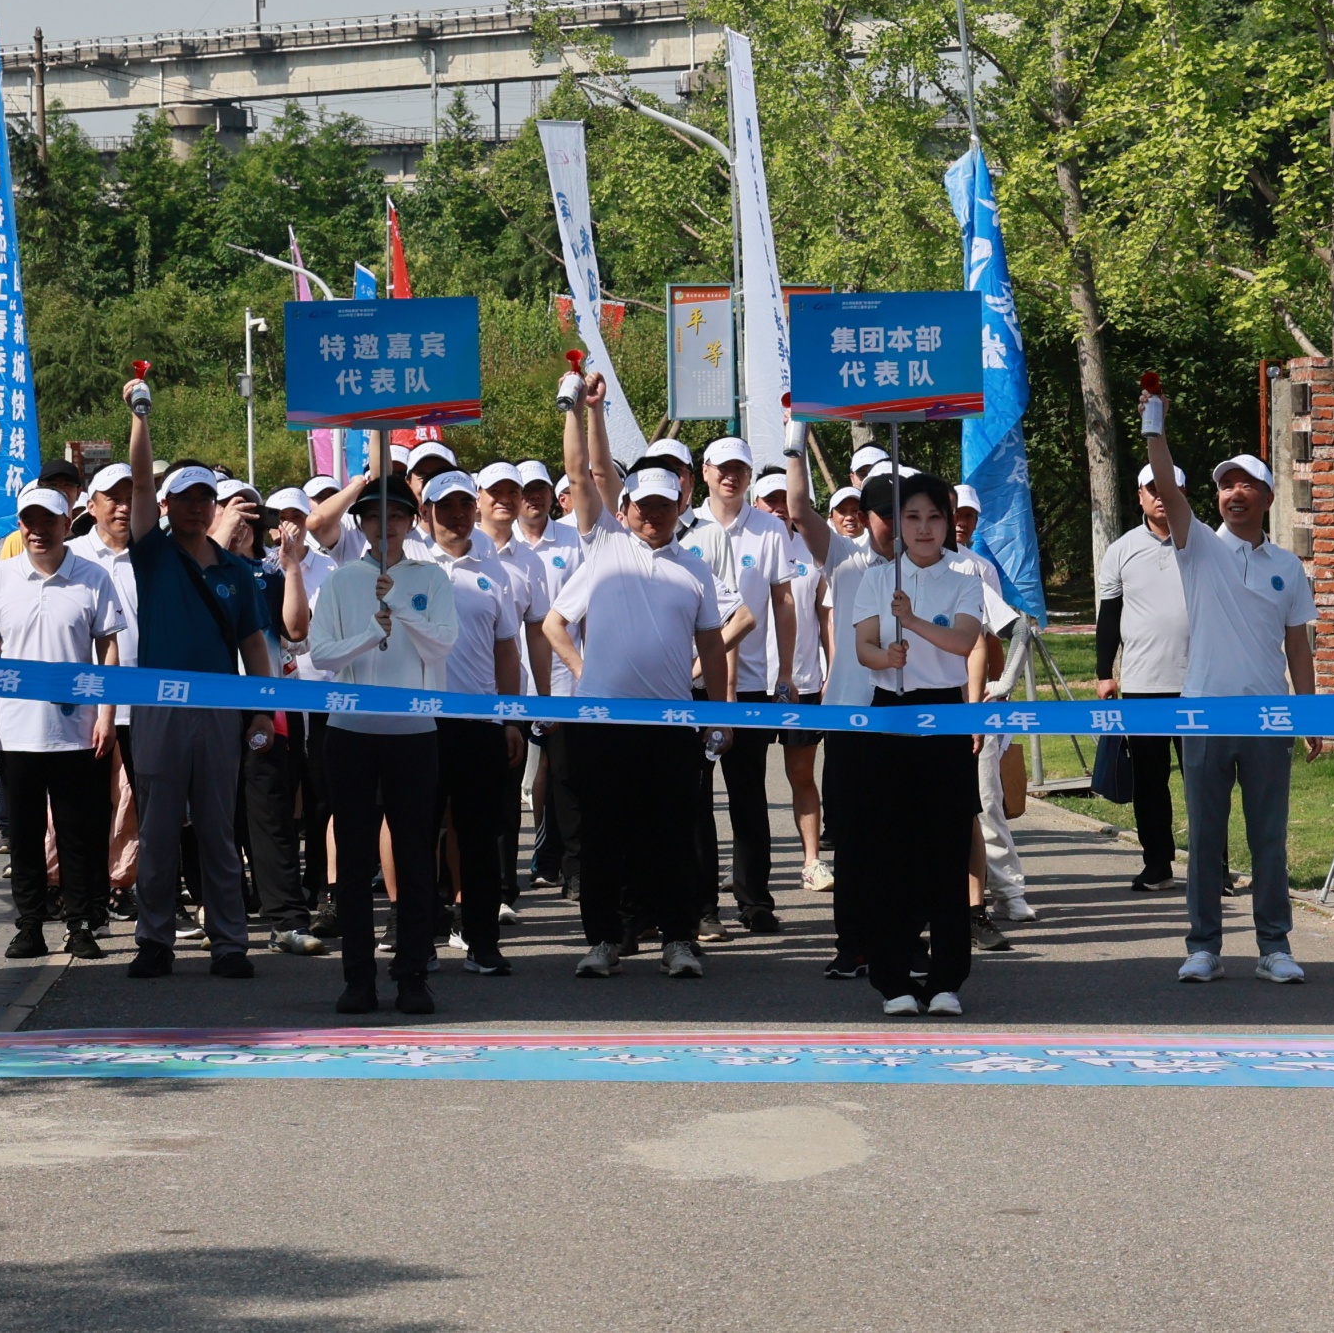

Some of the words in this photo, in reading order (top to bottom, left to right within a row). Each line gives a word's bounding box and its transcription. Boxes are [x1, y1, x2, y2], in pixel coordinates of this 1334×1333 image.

[319, 332, 446, 361] 特邀嘉宾
[685, 307, 724, 369] 平等
[830, 325, 942, 354] 集团本部
[335, 367, 431, 396] 代表队
[838, 360, 934, 388] 代表队
